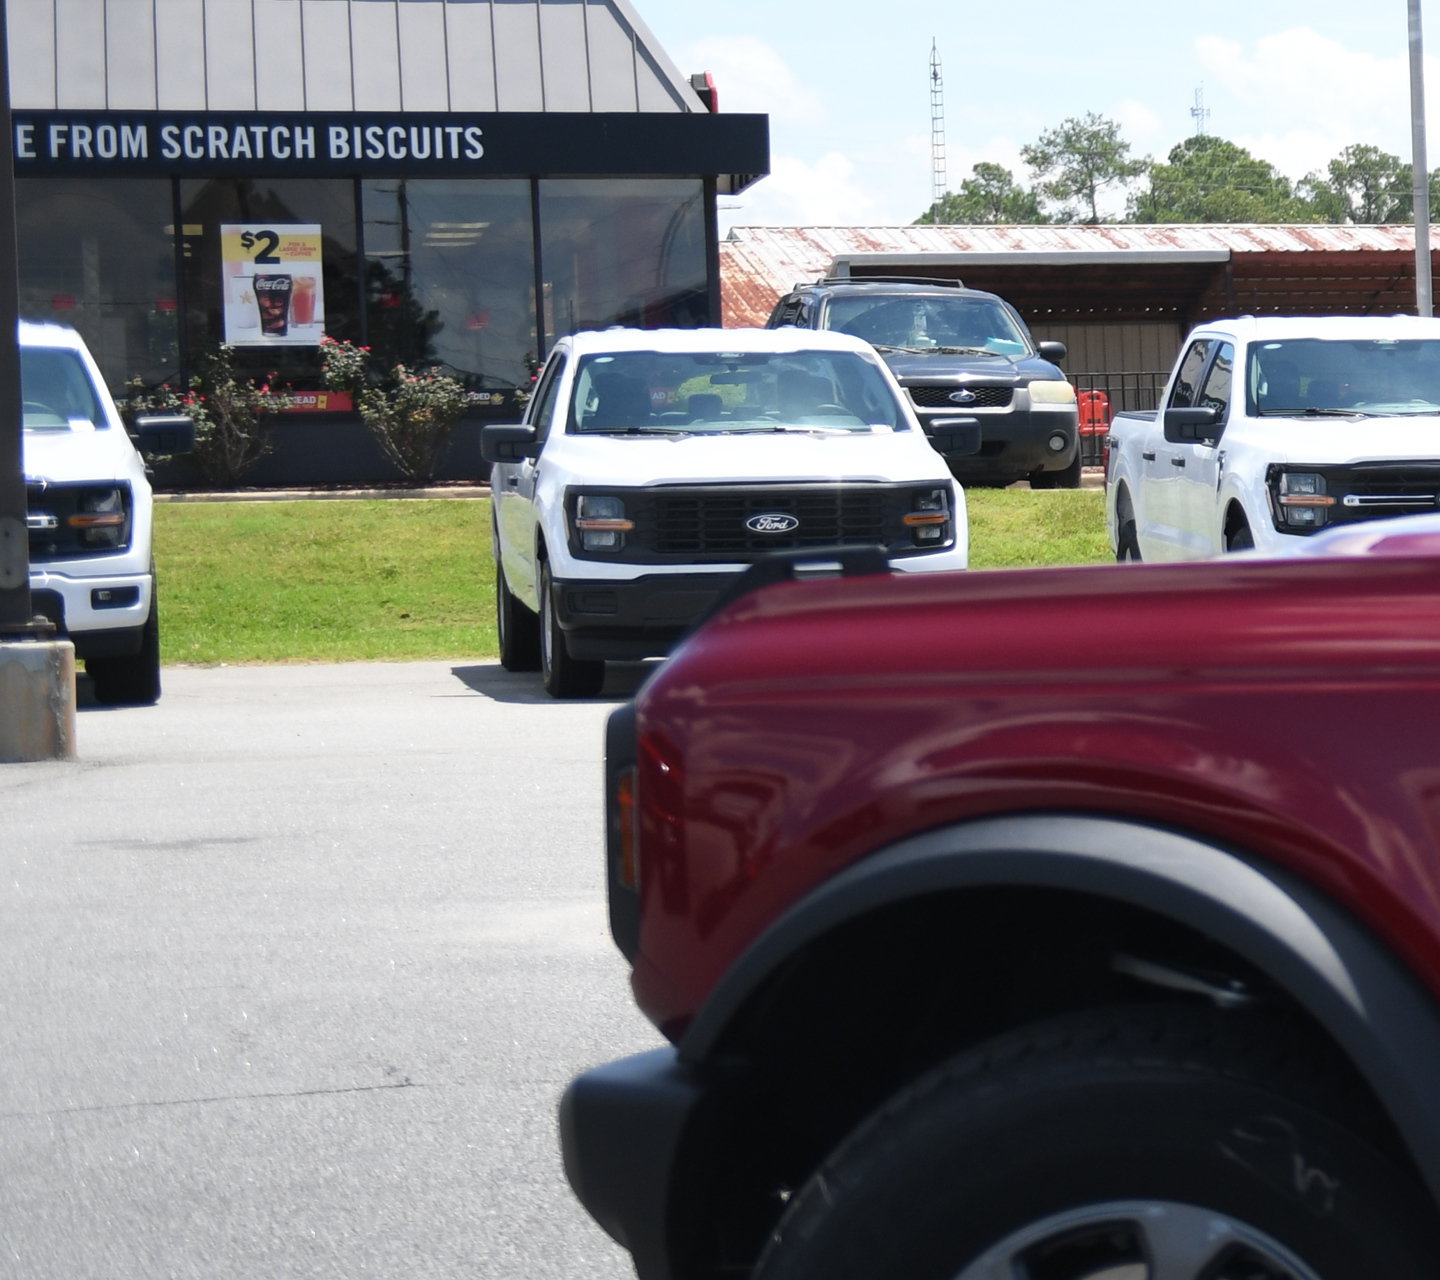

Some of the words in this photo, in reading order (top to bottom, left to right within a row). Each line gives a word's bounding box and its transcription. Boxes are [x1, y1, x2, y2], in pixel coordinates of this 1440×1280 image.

[49, 124, 148, 159] FROM
[161, 125, 316, 159] SCRATCH
[328, 126, 485, 160] BISCUITS
[240, 230, 281, 265] $2
[756, 516, 790, 530] Ford
